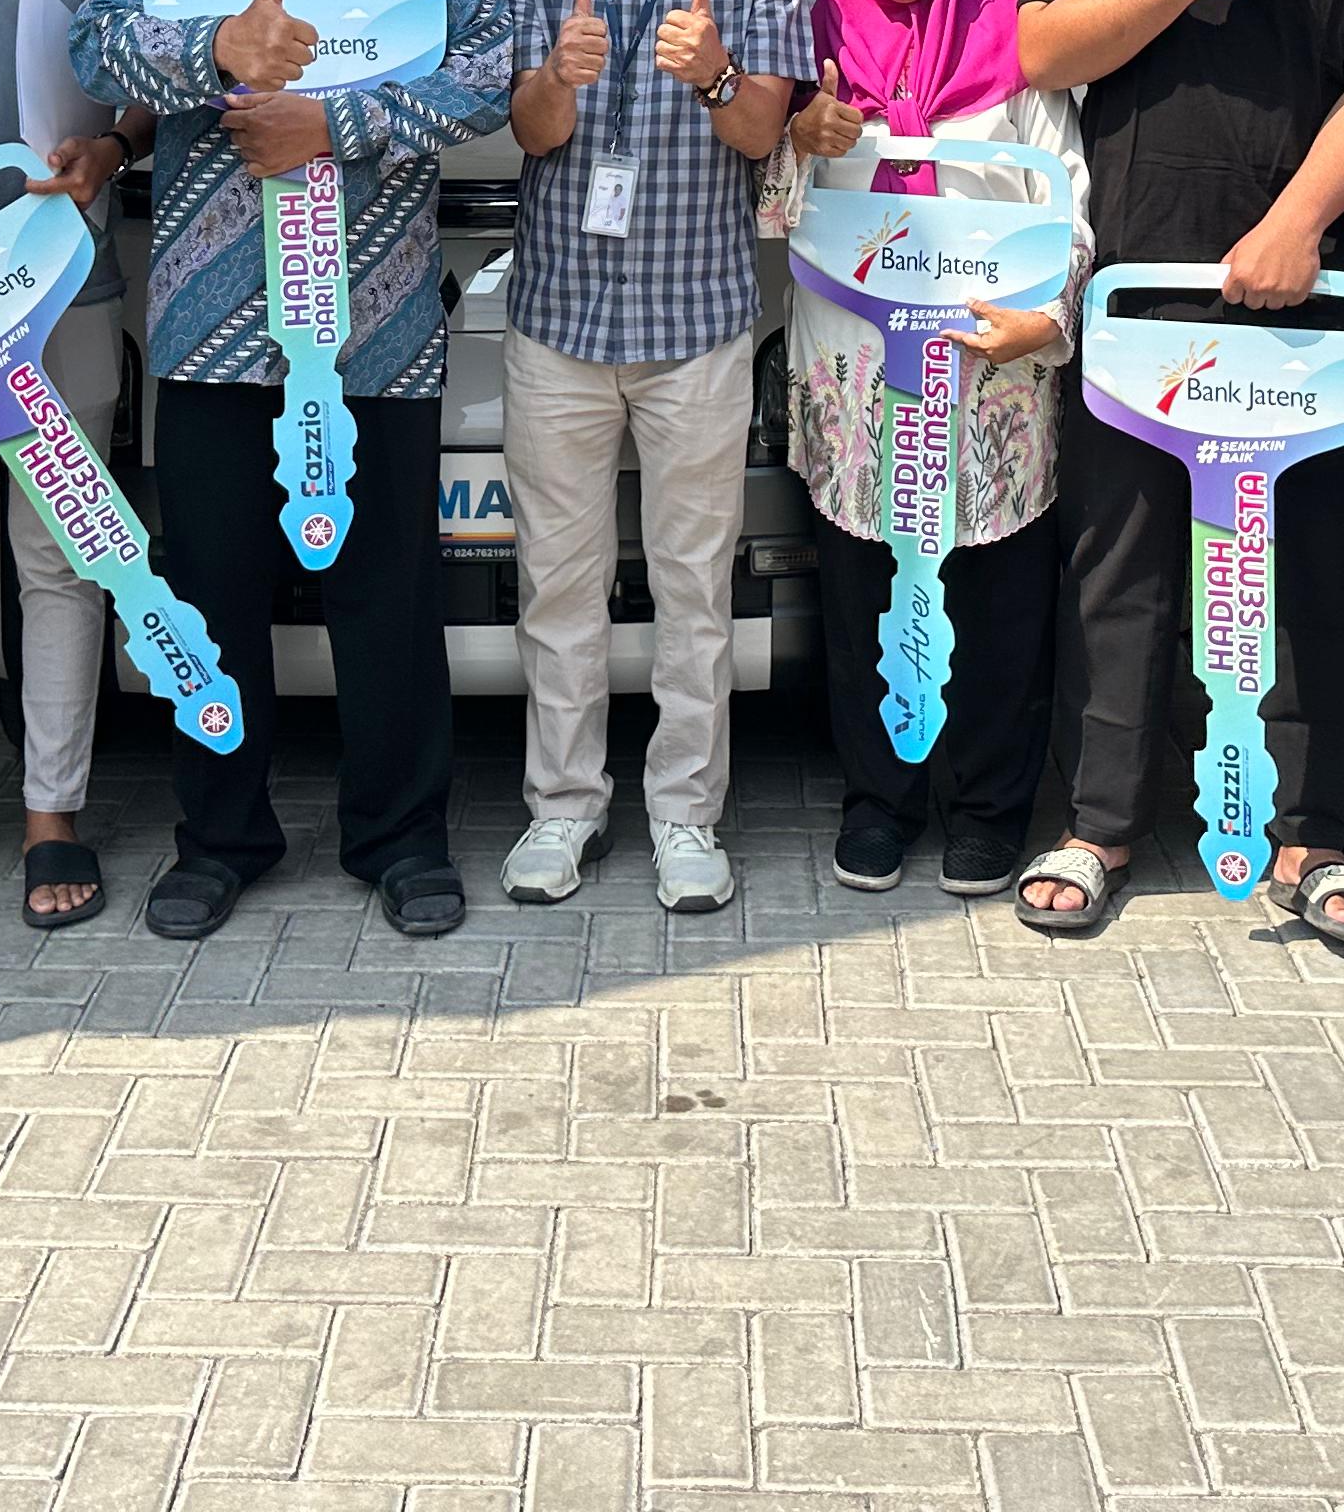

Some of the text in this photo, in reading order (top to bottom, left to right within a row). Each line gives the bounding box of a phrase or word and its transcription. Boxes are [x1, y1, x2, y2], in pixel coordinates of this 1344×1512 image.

[280, 194, 311, 327] HADIAH
[881, 247, 1000, 283] Bank Jateng
[316, 284, 337, 344] DARI
[910, 320, 941, 331] BAIK
[1187, 378, 1317, 415] Bank Jateng
[10, 363, 140, 563] DARI SEMESTA
[298, 400, 325, 497] Fazzio
[893, 405, 920, 533] HADIAH
[921, 340, 950, 555] DARI SEMESTA
[1220, 452, 1254, 464] BAIK
[19, 442, 107, 564] HADIAH
[1208, 541, 1234, 671] HADIAH
[1239, 474, 1267, 693] DARI SEMESTA
[143, 611, 204, 698] Fazzio
[918, 693, 926, 742] WULING
[1218, 743, 1240, 836] Fazzio
